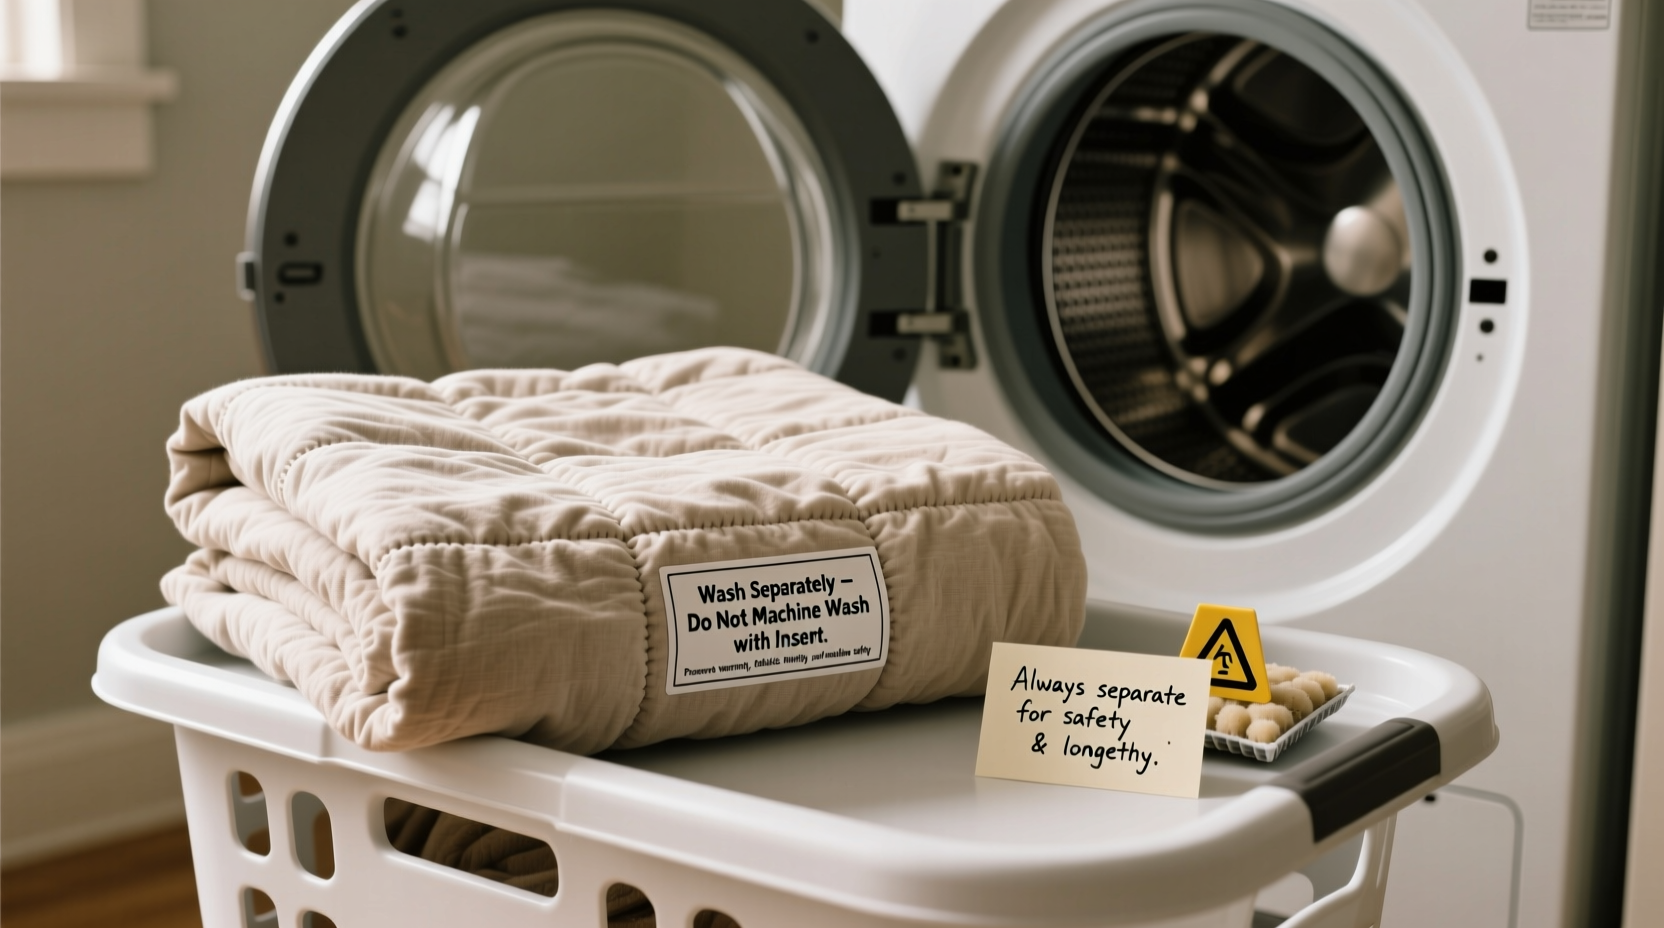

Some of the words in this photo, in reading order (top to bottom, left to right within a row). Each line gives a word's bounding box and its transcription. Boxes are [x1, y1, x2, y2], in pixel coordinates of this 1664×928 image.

[697, 581, 747, 605] Wash
[749, 573, 837, 603] Separately
[687, 612, 713, 633] Do
[716, 608, 749, 630] Not
[752, 602, 822, 626] Machine
[824, 594, 871, 618] Wash
[733, 630, 771, 654] with
[775, 626, 829, 649] Insert.
[1010, 665, 1086, 704] Always
[1096, 683, 1188, 709] separate
[1016, 698, 1053, 723] for
[1062, 706, 1132, 742] safety
[1030, 731, 1048, 755] &
